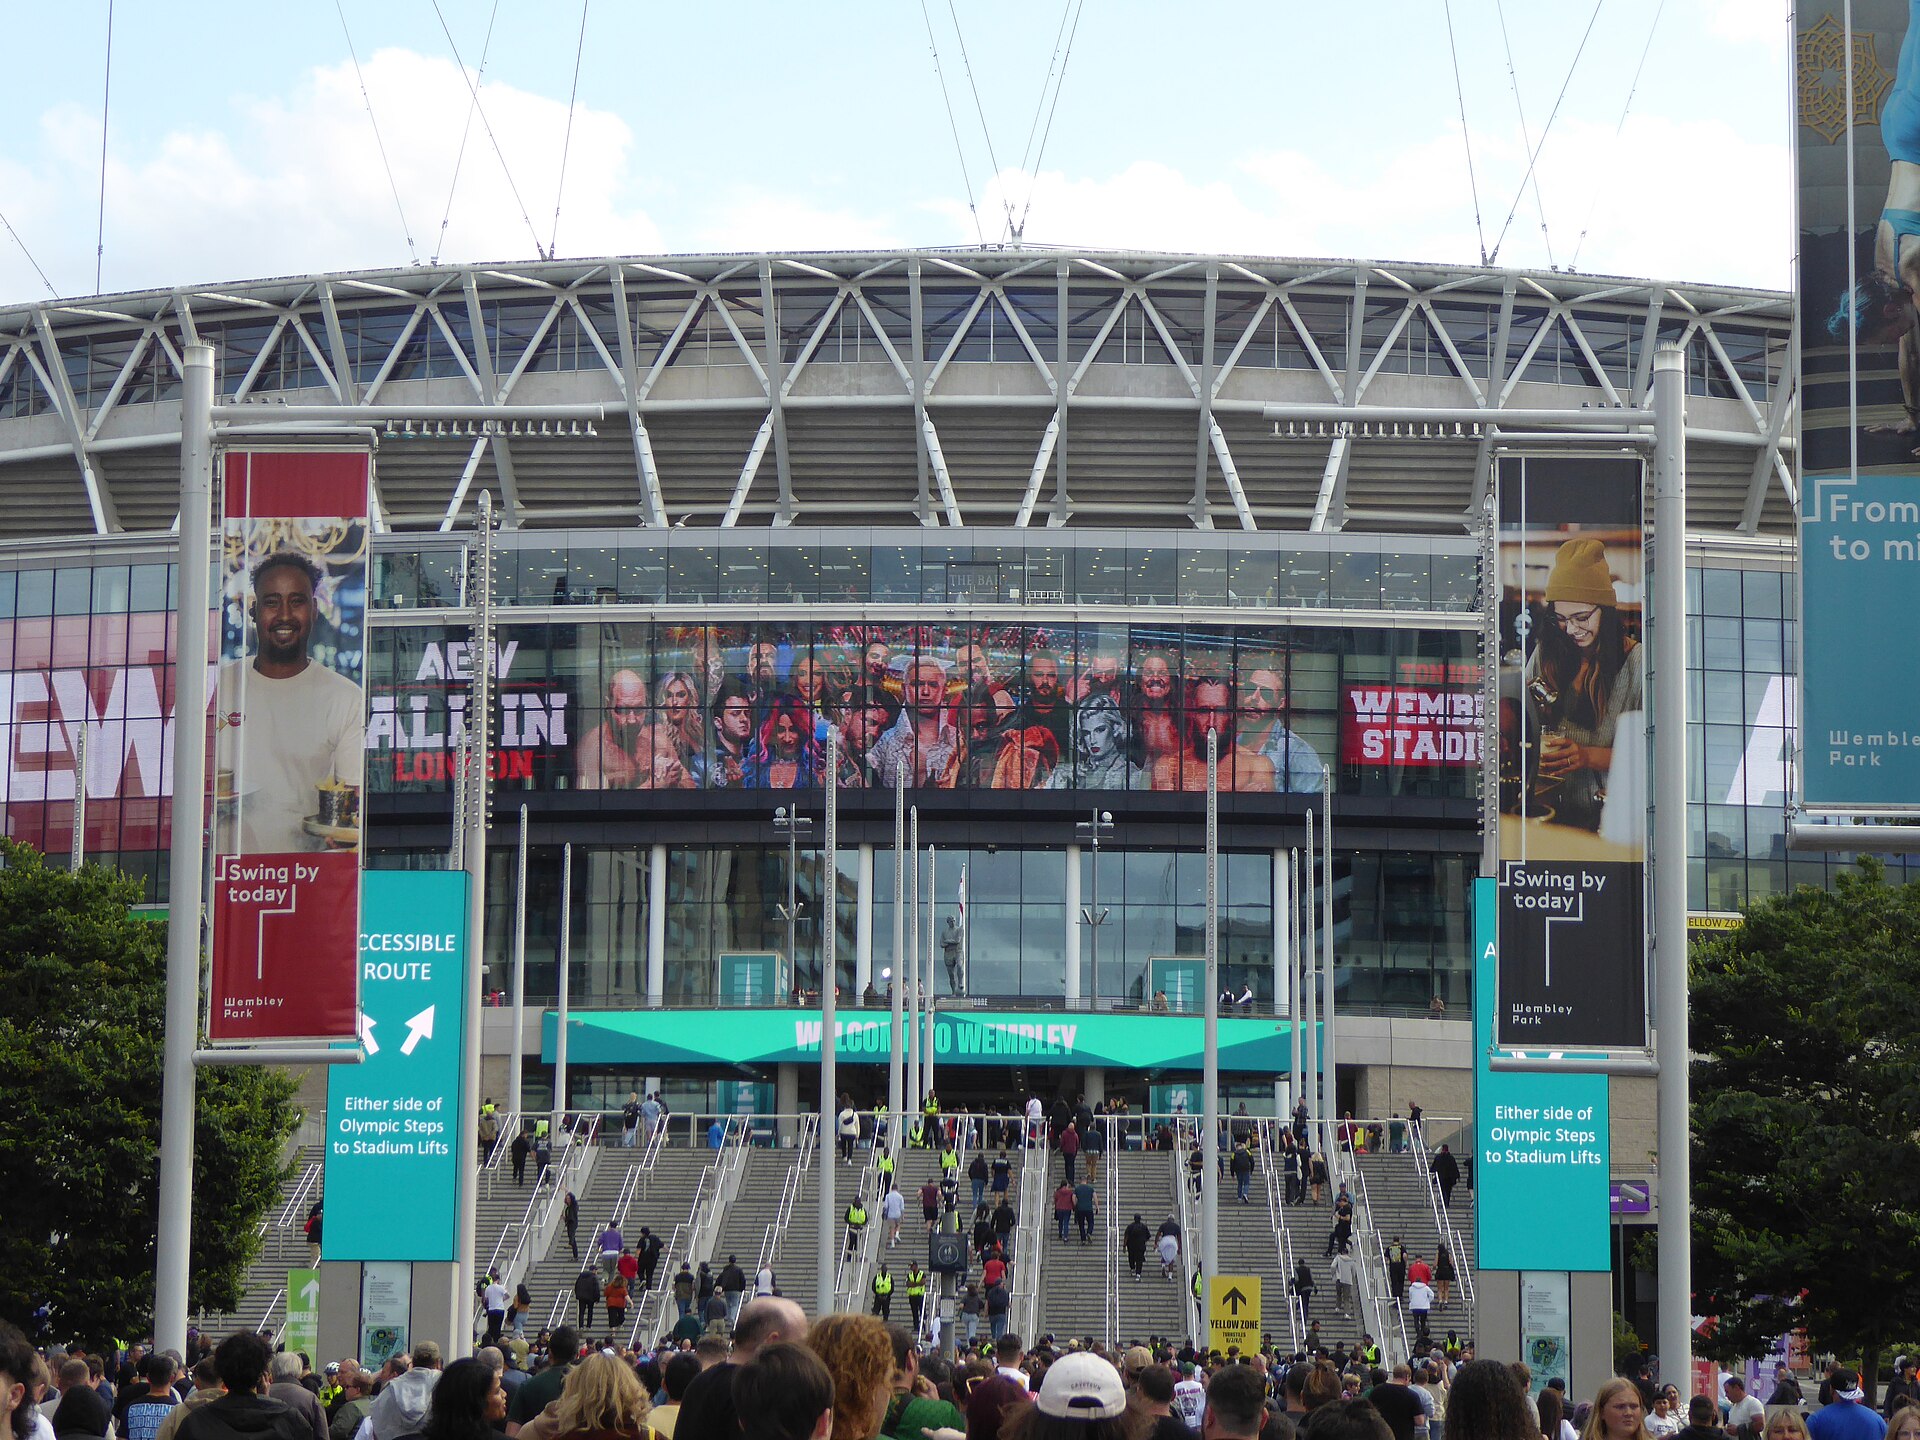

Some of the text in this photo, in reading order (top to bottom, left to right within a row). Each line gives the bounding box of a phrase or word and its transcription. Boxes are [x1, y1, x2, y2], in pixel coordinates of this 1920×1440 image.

[1830, 494, 1918, 522] From
[1829, 535, 1870, 561] to
[949, 574, 972, 586] THE
[501, 692, 568, 746] IN
[1829, 751, 1881, 766] Park
[228, 862, 319, 883] Swing by
[1513, 869, 1606, 891] Swing by
[228, 885, 287, 905] today
[1513, 891, 1574, 912] today
[364, 962, 431, 980] ROUTE
[224, 996, 284, 1007] Wembley
[1512, 1003, 1573, 1015] Wembley
[224, 1008, 253, 1018] Park
[1512, 1015, 1542, 1025] Park
[957, 1023, 1077, 1056] WEMBLEY
[345, 1097, 443, 1111] Either side of
[1495, 1105, 1593, 1120] Either side of
[340, 1118, 444, 1136] Olympic Steps
[1491, 1127, 1596, 1146] Olympic Steps
[333, 1140, 449, 1155] to Stadium Lifts
[1485, 1149, 1602, 1164] to Stadium Lifts
[1210, 1320, 1259, 1330] YELLOW ZONE
